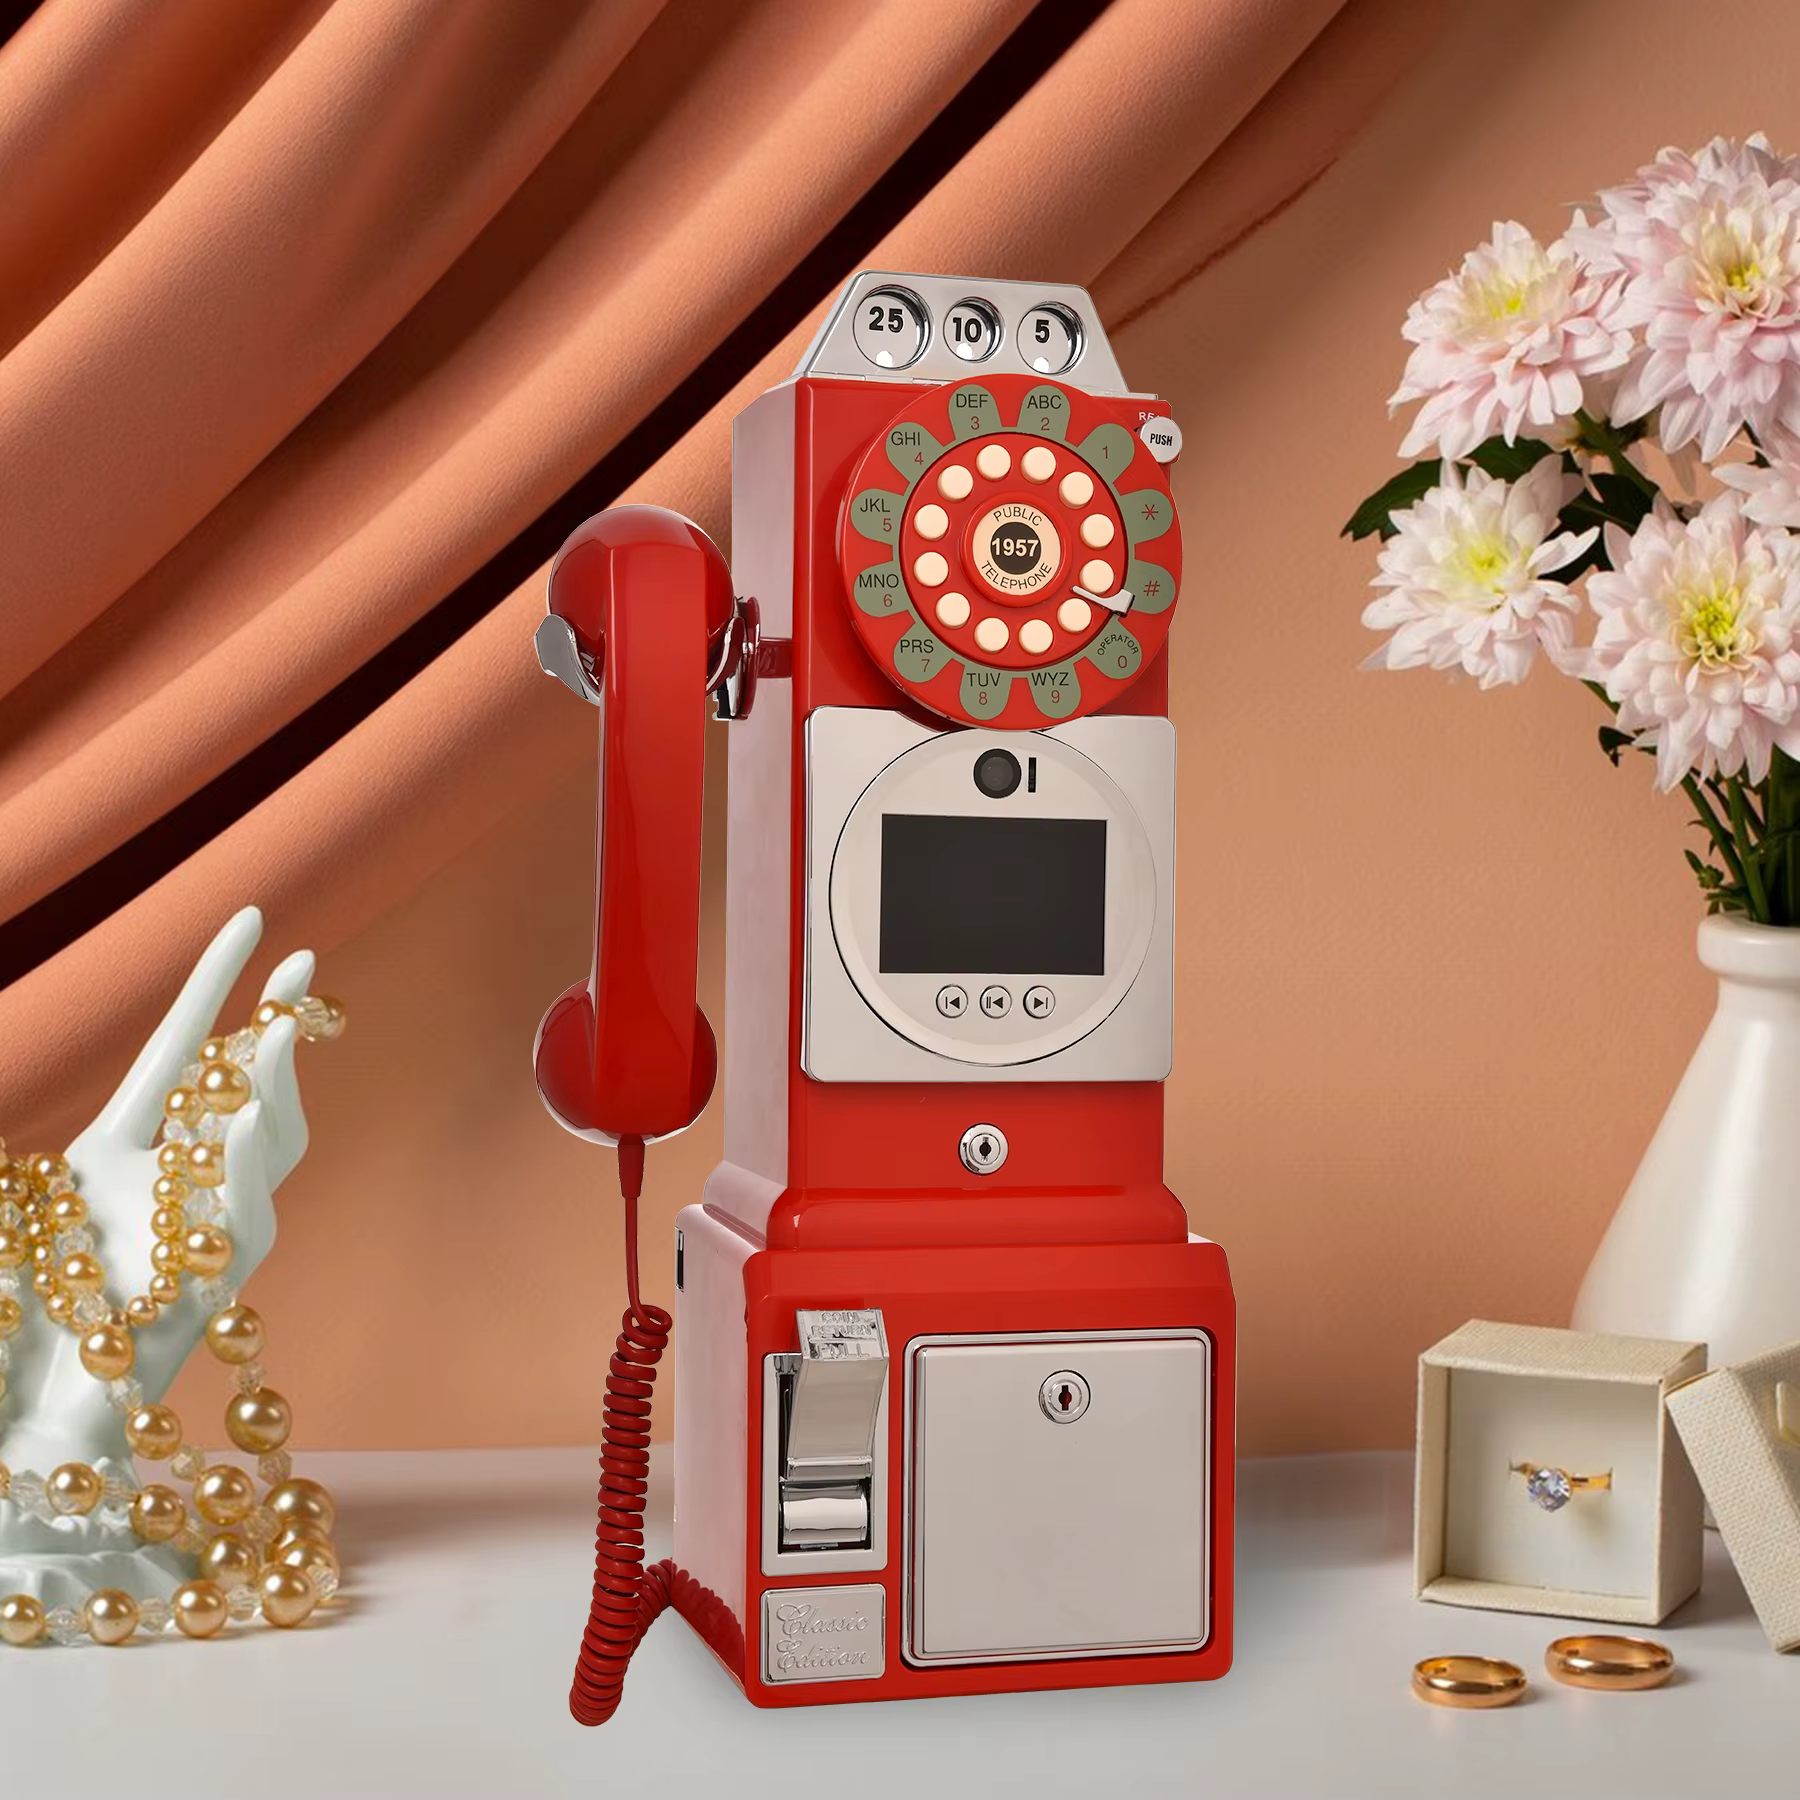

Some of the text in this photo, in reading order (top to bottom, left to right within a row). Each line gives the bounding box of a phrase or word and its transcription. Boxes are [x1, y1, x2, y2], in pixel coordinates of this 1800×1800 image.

[869, 306, 904, 333] 25
[952, 317, 983, 343] 10
[1034, 319, 1051, 344] 5
[956, 393, 989, 409] DEF
[1026, 394, 1062, 410] ABC
[970, 415, 980, 430] 3
[1138, 411, 1160, 421] RE
[1040, 417, 1050, 431] 2
[890, 431, 921, 446] GHI
[1149, 433, 1173, 447] PUSH
[914, 451, 924, 465] 4
[1102, 445, 1108, 459] 1
[859, 498, 891, 513] JKL
[993, 506, 1043, 527] PUBLIC
[882, 518, 892, 532] 5
[991, 537, 1039, 557] 1957
[858, 573, 899, 588] MNO
[981, 559, 1052, 590] TELEPHONE
[1143, 580, 1161, 597] #
[883, 593, 893, 608] 6
[900, 639, 934, 654] PRS
[1096, 634, 1139, 656] OPERATOR
[921, 658, 930, 673] 7
[1117, 655, 1128, 669] 0
[965, 672, 1001, 687] TUV
[1030, 672, 1070, 686] WYZ
[978, 691, 988, 706] 8
[1050, 689, 1060, 704] 9
[821, 1311, 861, 1323] COIN
[811, 1324, 872, 1336] RETURN
[776, 1603, 869, 1639] Classic
